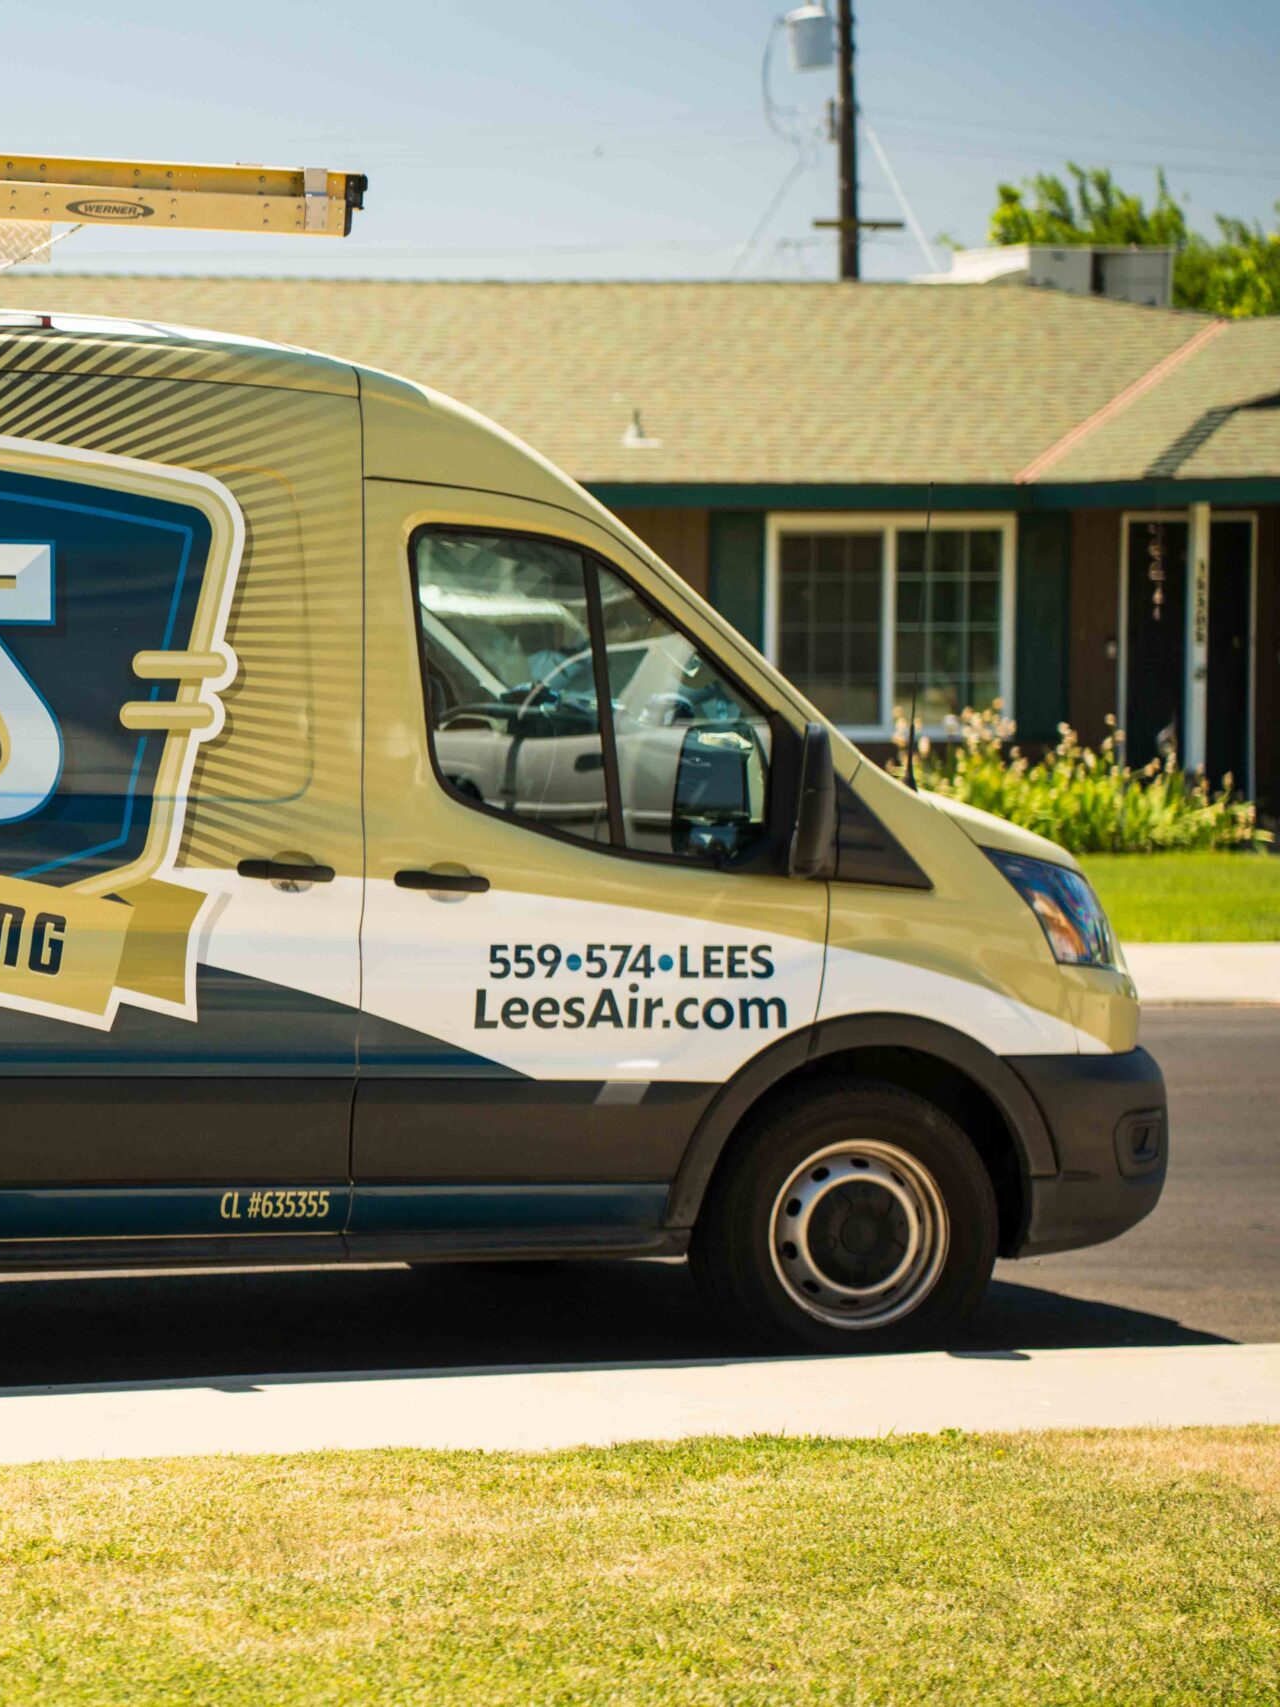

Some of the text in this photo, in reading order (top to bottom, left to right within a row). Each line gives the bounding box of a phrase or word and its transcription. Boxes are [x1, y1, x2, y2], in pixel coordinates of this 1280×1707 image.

[83, 203, 138, 215] WERNER
[473, 982, 788, 1030] LeesAir.com
[220, 1190, 330, 1219] CL #635355
